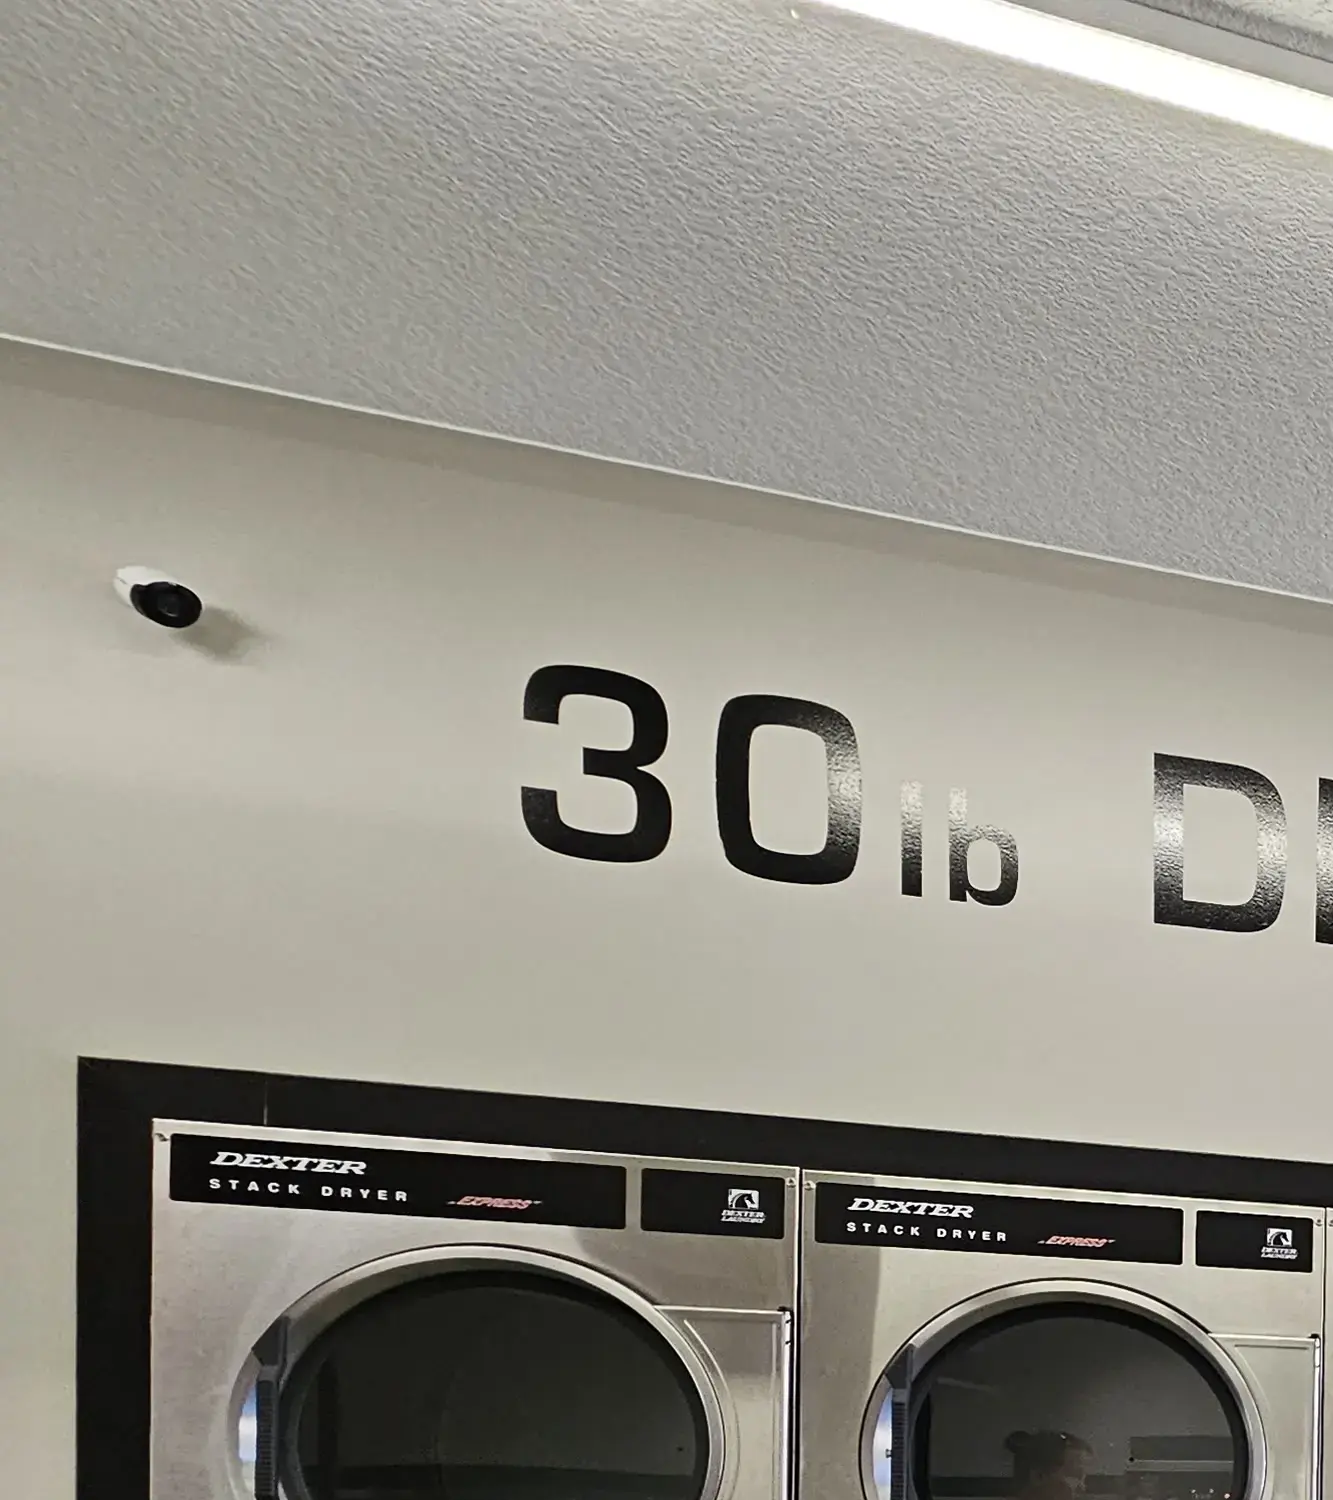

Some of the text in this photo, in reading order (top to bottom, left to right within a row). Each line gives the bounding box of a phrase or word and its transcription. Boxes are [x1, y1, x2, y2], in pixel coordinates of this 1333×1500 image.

[210, 1151, 367, 1175] DEXTER
[209, 1178, 409, 1202] STACK DRYER
[848, 1198, 974, 1219] DEXTER
[846, 1221, 1007, 1242] STACK DRYER
